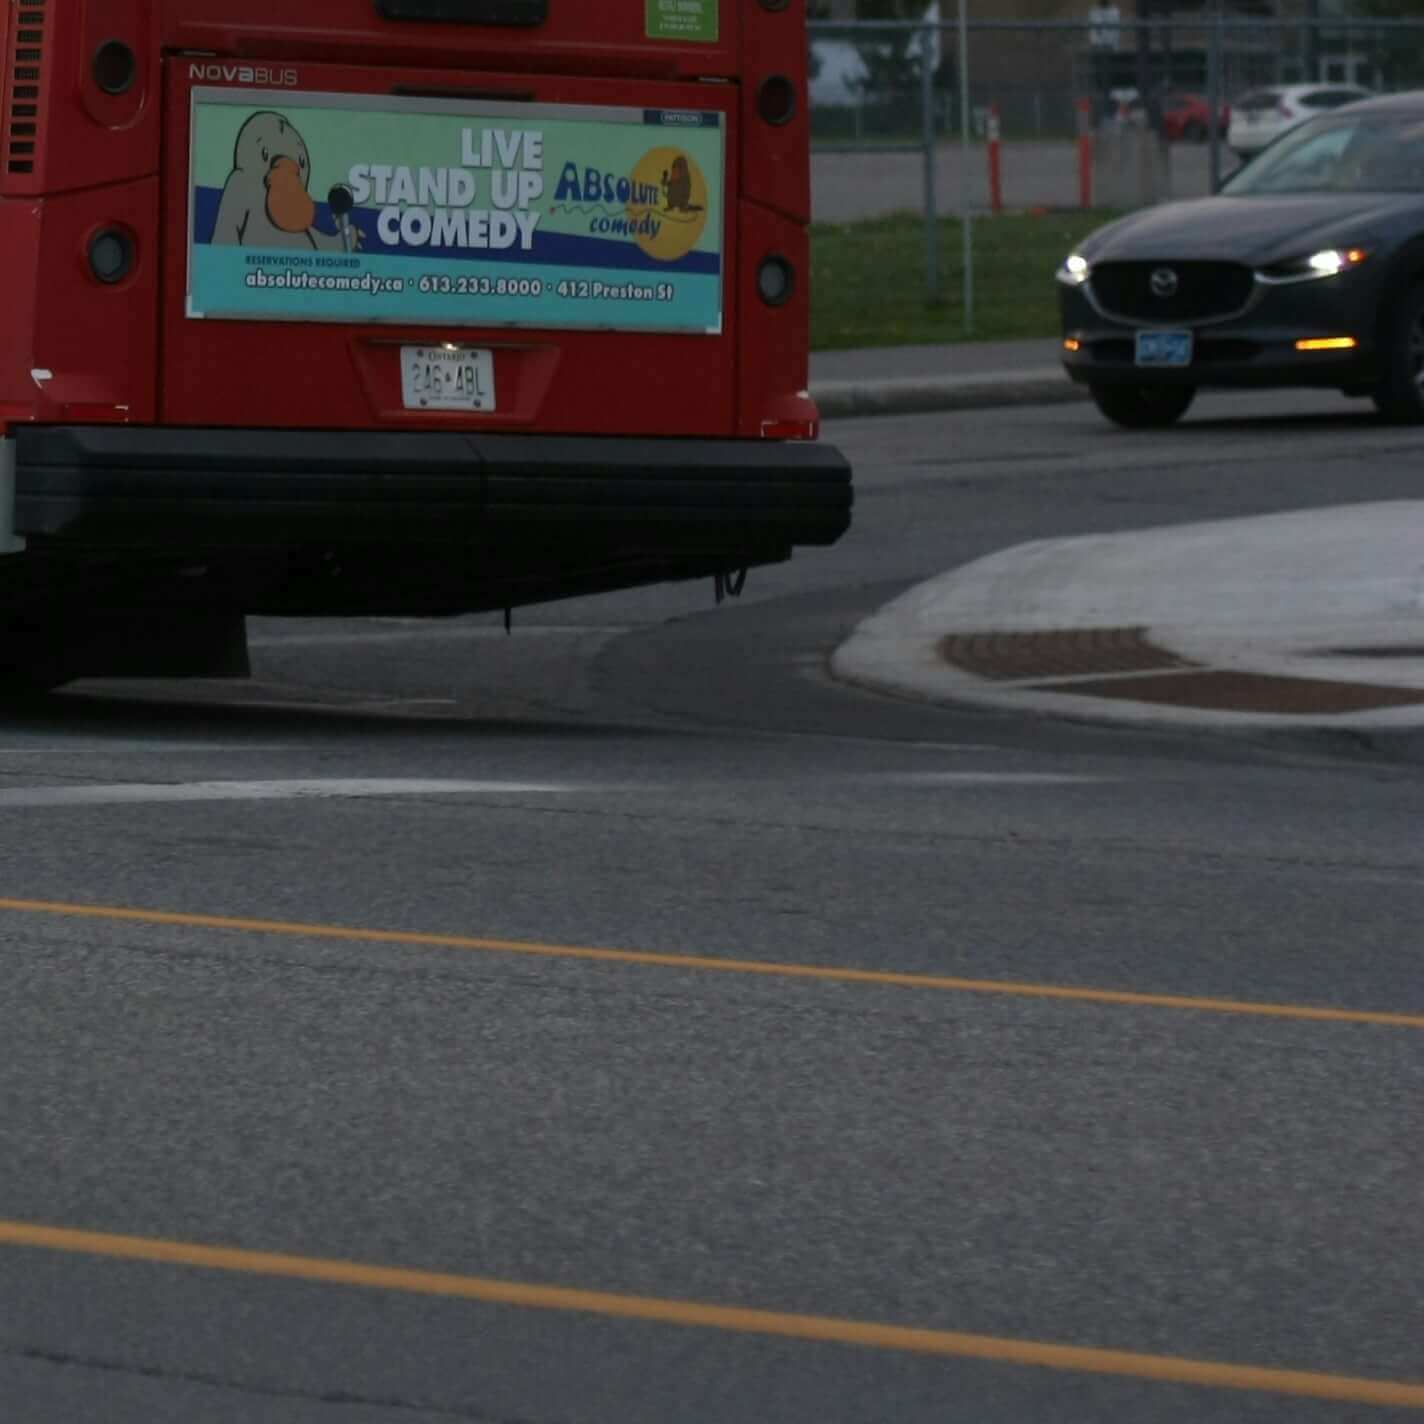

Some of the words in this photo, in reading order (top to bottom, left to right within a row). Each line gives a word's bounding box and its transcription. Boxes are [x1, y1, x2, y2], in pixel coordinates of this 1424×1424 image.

[460, 127, 544, 171] LIVE
[349, 164, 476, 208] STAND
[490, 170, 544, 211] UP
[554, 160, 659, 205] ABSOLUTE
[376, 208, 542, 250] COMEDY
[589, 214, 661, 240] comedy
[246, 255, 313, 267] RESERVATIONS
[315, 257, 361, 268] REQUIRED
[246, 269, 403, 295] absolutecomedy.ca
[419, 275, 542, 298] 613.233.8000
[556, 281, 589, 300] 412
[592, 282, 654, 302] Preston
[656, 284, 674, 302] St
